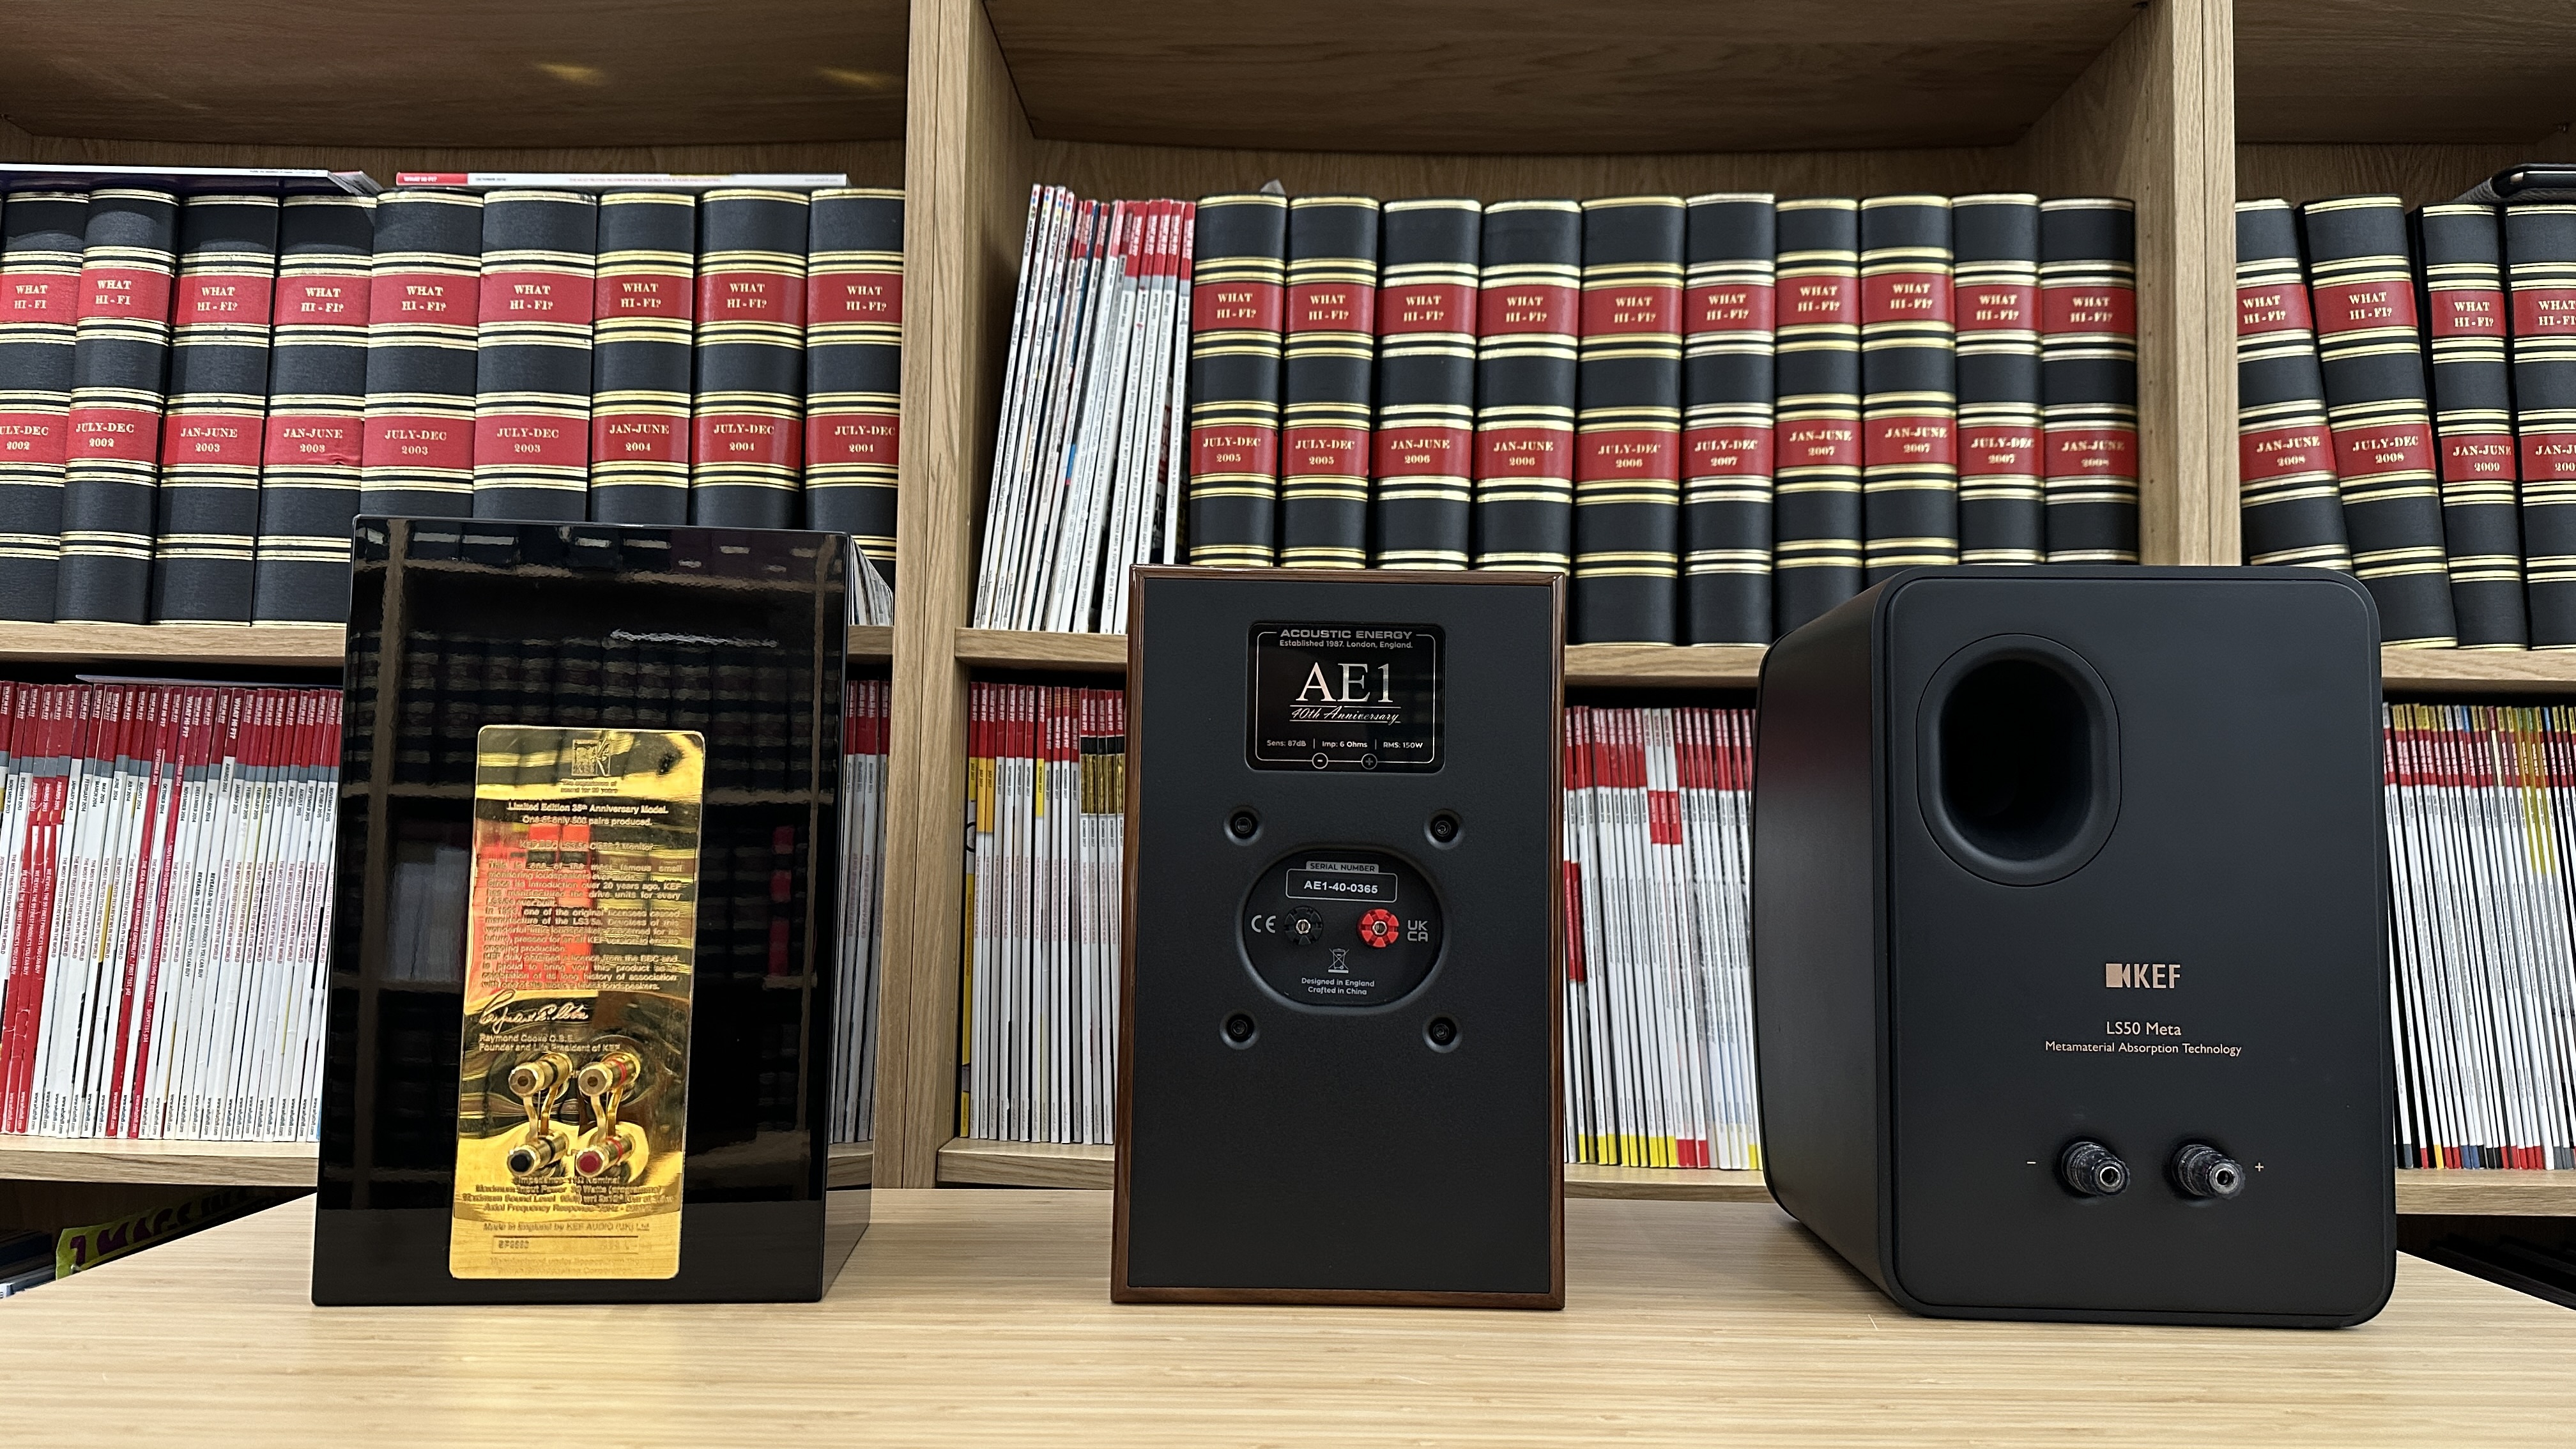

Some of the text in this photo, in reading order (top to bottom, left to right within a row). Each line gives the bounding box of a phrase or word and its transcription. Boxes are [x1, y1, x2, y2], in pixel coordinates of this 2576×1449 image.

[16, 285, 48, 294] WHAT
[98, 280, 131, 289] WHAT
[623, 283, 658, 292] WHAT
[730, 284, 765, 292] WHAT
[1893, 284, 1930, 293] WHAT
[202, 287, 235, 296] WHAT
[305, 288, 341, 297] WHAT
[406, 286, 443, 296] WHAT
[514, 285, 550, 295] WHAT
[847, 286, 880, 295] WHAT
[1800, 286, 1837, 296] WHAT
[1218, 293, 1252, 302] WHAT
[1310, 295, 1346, 304] WHAT
[1406, 296, 1441, 305] WHAT
[1507, 296, 1543, 306] WHAT
[1616, 297, 1652, 307] WHAT
[1709, 294, 1746, 305] WHAT
[1979, 295, 2017, 305] WHAT
[2073, 297, 2108, 307] WHAT
[2243, 295, 2280, 308] WHAT
[2349, 292, 2386, 304] WHAT
[2455, 302, 2489, 311] WHAT
[2538, 300, 2575, 310] WHAT
[0, 426, 49, 435] ULY-DEC
[76, 422, 134, 433] JULY-DEC
[181, 427, 237, 438] JAN-JUNE
[610, 424, 669, 434] JAN-JUNE
[714, 424, 774, 434] JULY-DEC
[834, 425, 895, 436] JULY-DEC
[1885, 427, 1947, 438] JAN-JUNE
[284, 429, 342, 438] JAN-JUNE
[385, 430, 446, 440] JULY-DEC
[497, 428, 558, 438] JULY-DEC
[1790, 430, 1853, 441] JAN-JUNE
[7, 441, 29, 450] 2002
[89, 438, 114, 447] 2002
[626, 442, 650, 451] 2004
[730, 442, 754, 450] 2004
[1203, 437, 1261, 447] JULY-DEC
[1296, 440, 1354, 449] JULY-DEC
[1392, 440, 1450, 449] JAN-JUNE
[1494, 441, 1553, 451] JAN-JUNE
[1695, 440, 1758, 451] JULY-DEC
[1972, 438, 2034, 448] JULY-DEC
[2257, 436, 2320, 452] JAN-JUNE
[2353, 436, 2418, 451] JULY-DEC
[195, 443, 220, 452] 2003
[300, 444, 325, 452] 2003
[402, 446, 428, 455] 2003
[514, 444, 540, 452] 2003
[849, 444, 873, 452] 2004
[1598, 444, 1660, 454] JULY-DEC
[1808, 446, 1836, 456] 2007
[1904, 443, 1930, 453] 2007
[2453, 445, 2510, 456] JAN-JUNE
[1405, 455, 1430, 463] 2006
[1510, 457, 1535, 466] 2006
[1711, 457, 1737, 466] 2007
[1989, 454, 2015, 463] 2007
[2278, 456, 2306, 466] 2008
[2375, 452, 2404, 463] 2008
[1616, 459, 1643, 468] 2006
[2474, 463, 2499, 471] 2009
[1280, 629, 1412, 639] ACOUSTIC ENERGY
[1296, 663, 1393, 702] AE1
[1292, 706, 1399, 725] 40th Anniversary
[508, 802, 539, 811] Limited
[541, 802, 570, 811] Edition
[590, 805, 639, 815] Anniversary
[640, 805, 668, 813] Model.
[523, 815, 538, 824] One
[553, 816, 569, 825] only
[572, 816, 586, 824] 500
[589, 817, 609, 825] pairs
[611, 818, 652, 826] produced.
[1304, 880, 1377, 893] AE1-40-0365
[1407, 920, 1428, 931] UK
[1407, 931, 1428, 942] CA
[2135, 964, 2181, 988] KEF
[1301, 977, 1335, 986] Designed
[1346, 979, 1374, 987] England
[2107, 1022, 2181, 1035] LS50 Meta
[479, 1034, 519, 1042] Raymond
[521, 1034, 547, 1042] Cooke
[2046, 1041, 2241, 1056] Metamaterial Absorption Technology
